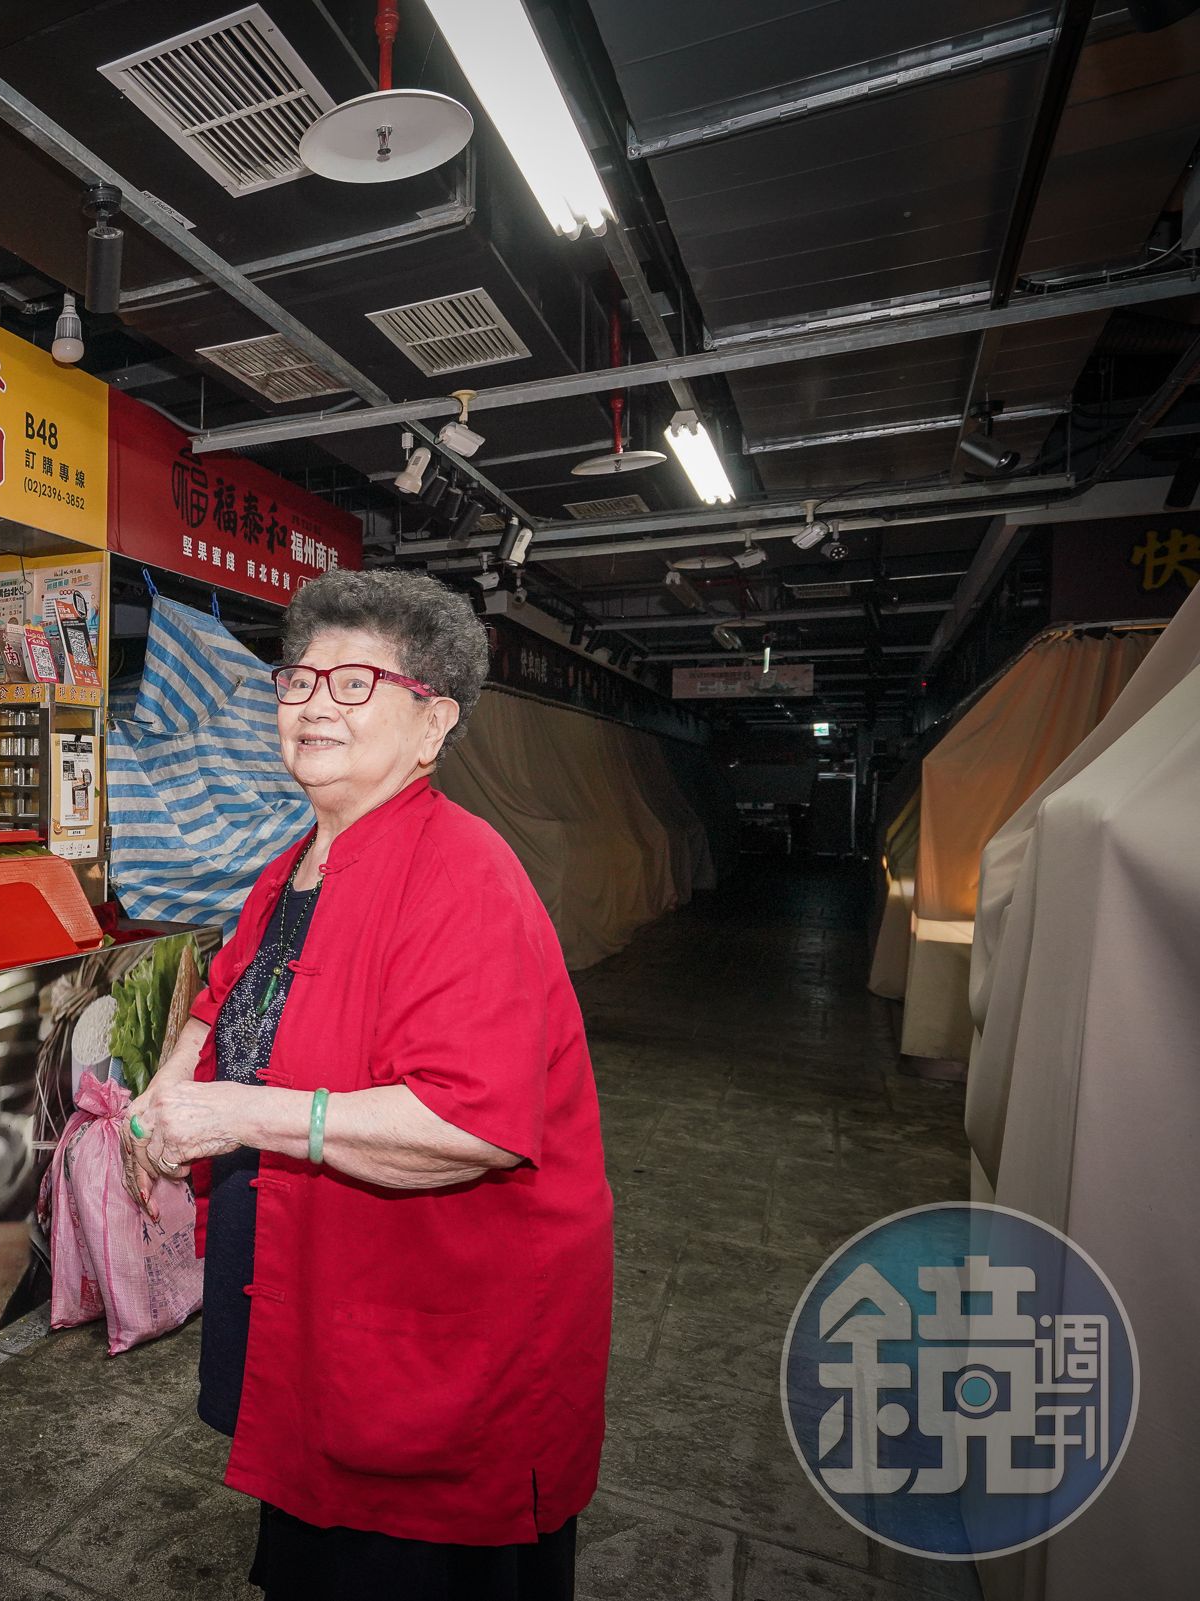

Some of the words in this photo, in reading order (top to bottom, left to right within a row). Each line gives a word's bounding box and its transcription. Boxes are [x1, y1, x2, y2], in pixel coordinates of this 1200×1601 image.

[25, 411, 58, 450] B48
[24, 448, 86, 490] 訂購專線
[23, 478, 85, 511] (02)2396-3852
